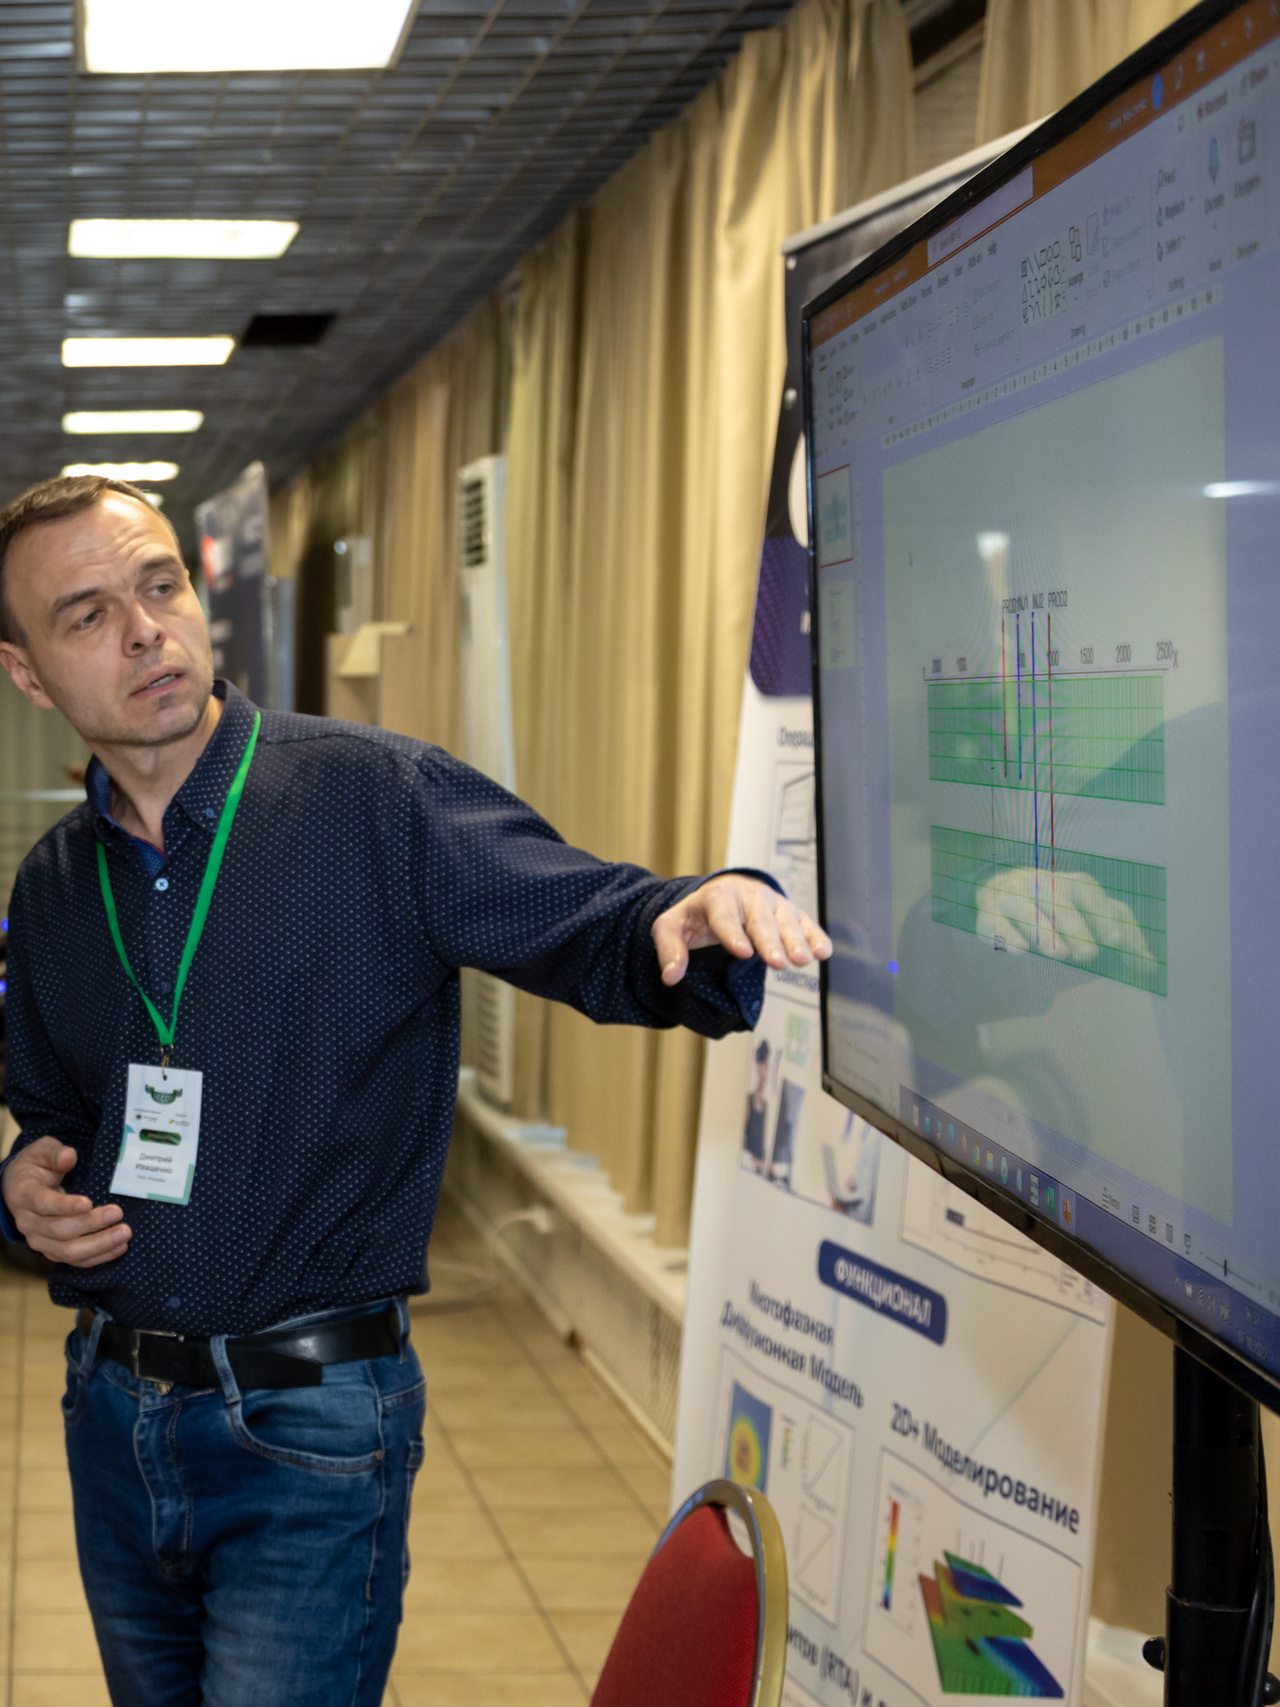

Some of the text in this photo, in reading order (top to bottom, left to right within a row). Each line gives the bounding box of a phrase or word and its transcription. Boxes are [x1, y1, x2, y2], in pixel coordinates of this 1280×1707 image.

[1048, 590, 1068, 608] PROD2
[1080, 647, 1094, 664] 1500
[1115, 644, 1131, 663] 2000
[1156, 641, 1173, 661] 2500
[833, 1255, 934, 1329] ФУНКЦИОНАЛ
[922, 1422, 1081, 1535] Моделирование
